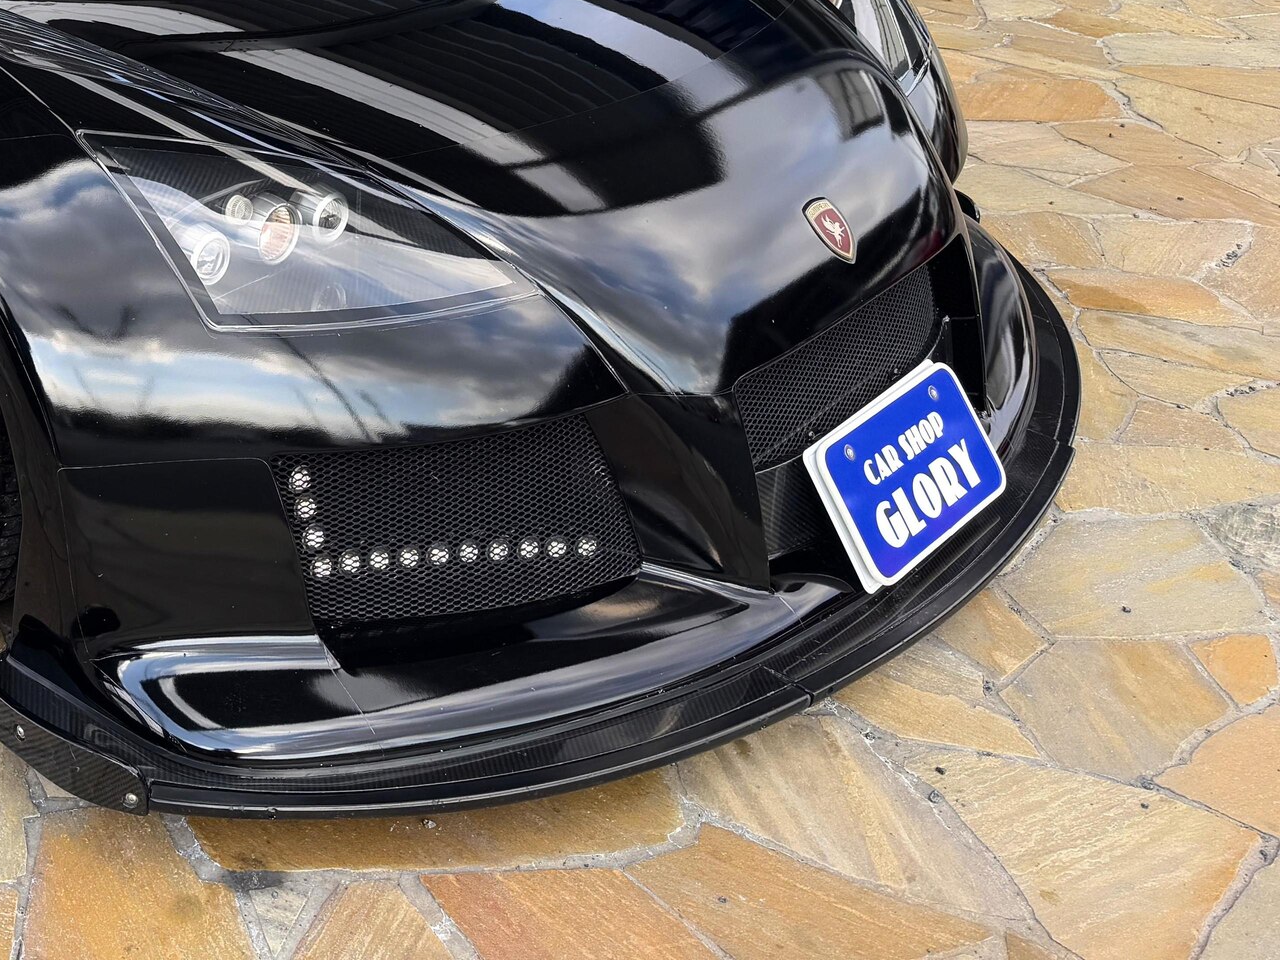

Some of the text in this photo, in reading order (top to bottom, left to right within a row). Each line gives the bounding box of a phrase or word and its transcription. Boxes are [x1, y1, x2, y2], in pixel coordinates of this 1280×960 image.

[863, 411, 944, 486] CAR SHOP
[876, 438, 981, 548] GLORY
